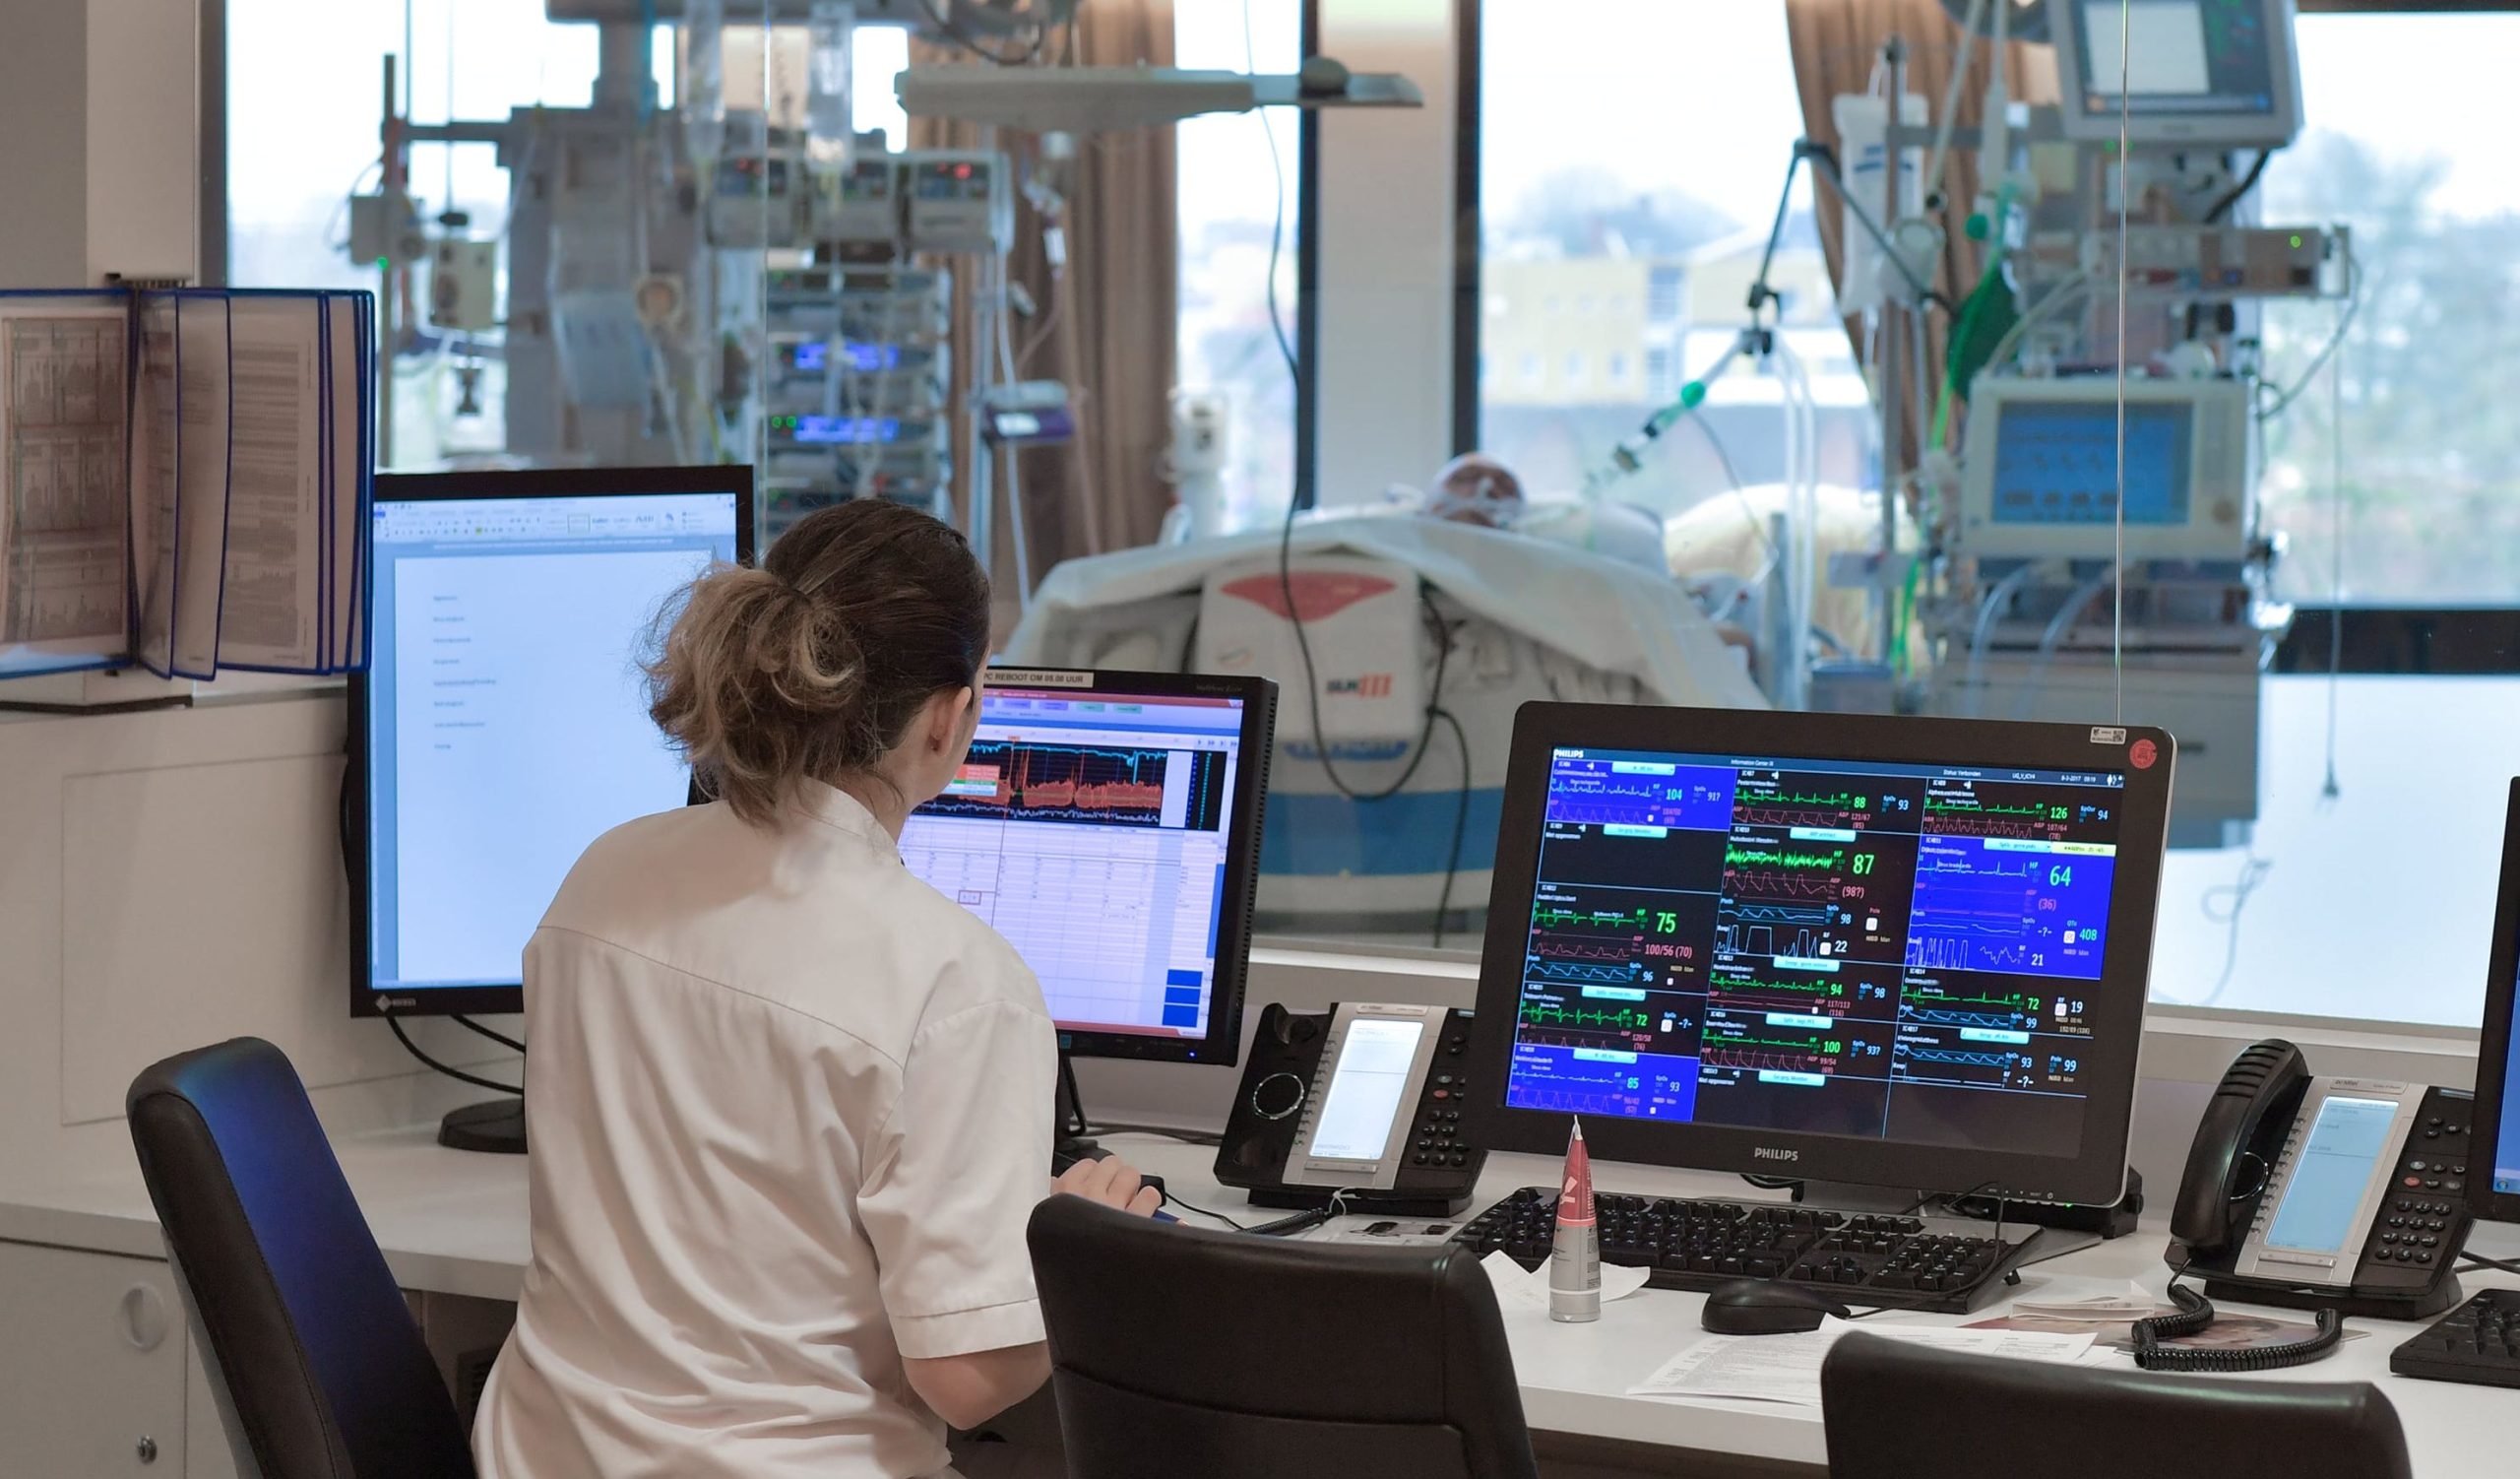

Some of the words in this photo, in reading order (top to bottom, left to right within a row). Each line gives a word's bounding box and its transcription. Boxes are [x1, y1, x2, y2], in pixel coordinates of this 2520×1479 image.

[1553, 748, 1584, 758] PHILIPS
[1666, 789, 1683, 802] 104
[1854, 797, 1866, 809] 88
[1898, 800, 1910, 810] 93
[2049, 807, 2067, 819] 126
[2097, 809, 2109, 820] 94
[1853, 854, 1874, 874] 87
[2049, 865, 2071, 886] 64
[1842, 886, 1864, 900] (98?)
[2038, 898, 2057, 911] (36)
[1656, 912, 1677, 933] 75
[1840, 914, 1852, 926] 98
[2079, 929, 2098, 941] 408
[1645, 943, 1673, 956] 100/56
[1675, 946, 1693, 959] (70)
[1835, 940, 1848, 953] 22
[2032, 953, 2044, 966] 21
[1642, 971, 1654, 982] 96
[1831, 983, 1843, 996] 94
[1874, 988, 1886, 998] 98
[2028, 997, 2040, 1010] 72
[2071, 1000, 2083, 1013] 19
[1636, 1014, 1648, 1026] 72
[2026, 1018, 2038, 1029] 99
[1823, 1041, 1841, 1054] 100
[1866, 1046, 1881, 1056] 93?
[2021, 1058, 2033, 1068] 93
[2064, 1060, 2077, 1071] 99
[1626, 1077, 1639, 1089] 85
[1670, 1081, 1680, 1092] 93
[1754, 1147, 1798, 1161] PHILIPS
